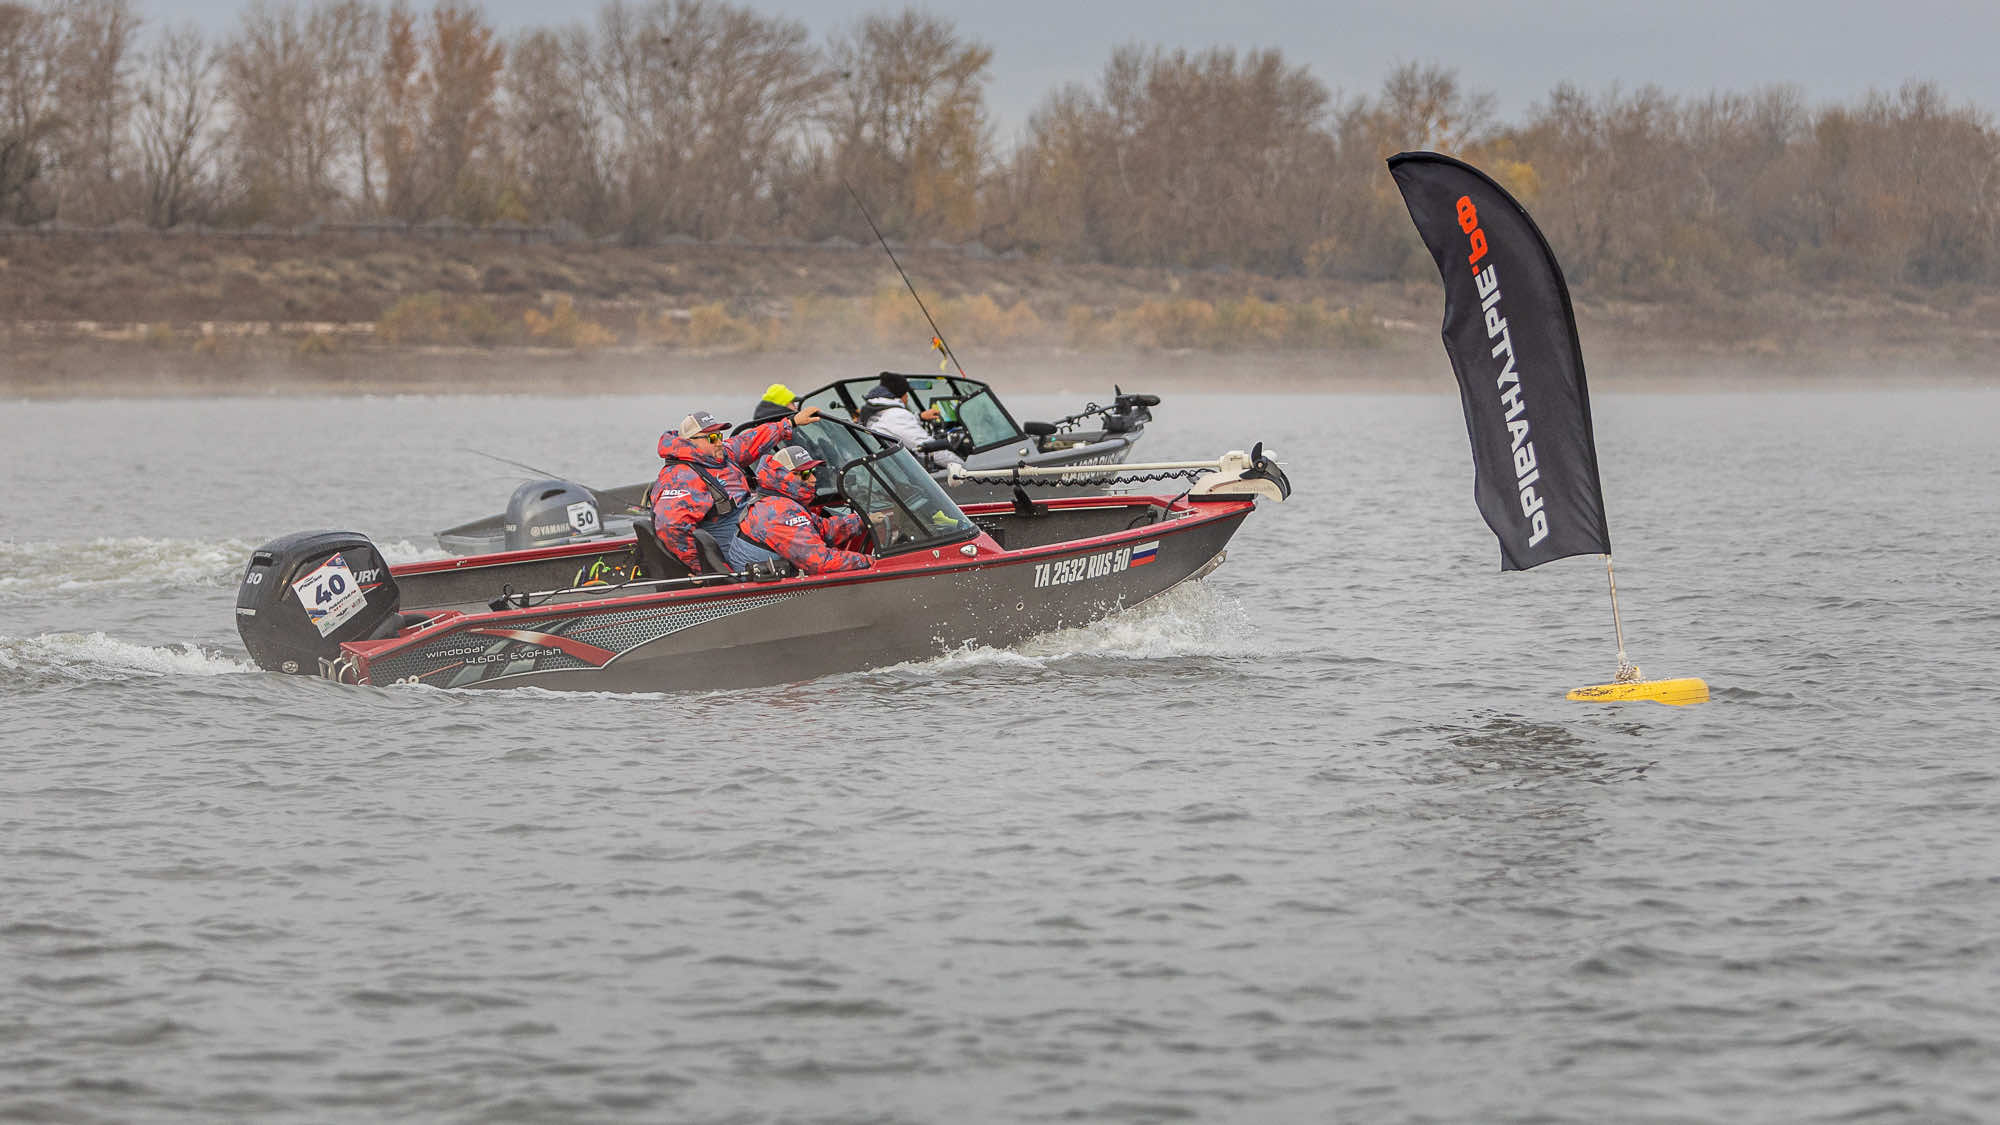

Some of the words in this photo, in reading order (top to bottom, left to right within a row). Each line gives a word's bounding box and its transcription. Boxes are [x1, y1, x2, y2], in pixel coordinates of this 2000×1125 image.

[577, 511, 593, 527] 50
[540, 523, 570, 536] YAMAHA
[1034, 563, 1050, 588] TA
[1051, 557, 1087, 585] 2532
[1086, 551, 1112, 579] RUS
[1112, 547, 1131, 573] 50
[247, 573, 263, 584] 80
[315, 574, 346, 605] 40
